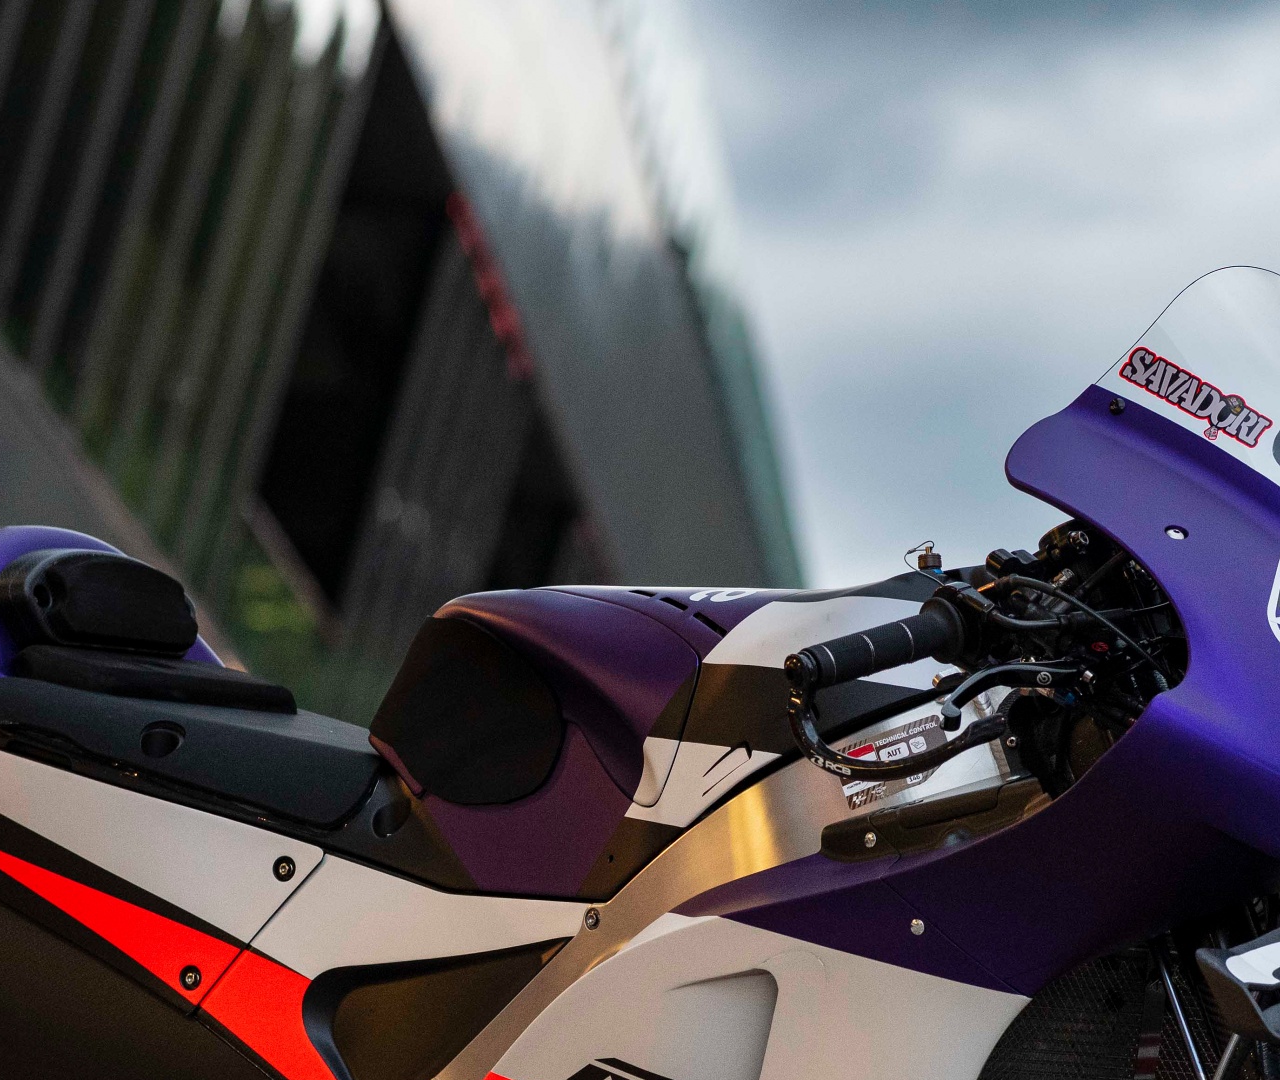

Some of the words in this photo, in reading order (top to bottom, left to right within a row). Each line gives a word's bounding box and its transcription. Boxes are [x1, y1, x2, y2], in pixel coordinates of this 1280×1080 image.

[1120, 347, 1272, 447] SAVADORI
[875, 731, 908, 747] TECHNICAL
[909, 722, 938, 736] CONTROL
[887, 748, 901, 758] AUT
[825, 762, 851, 775] RCB
